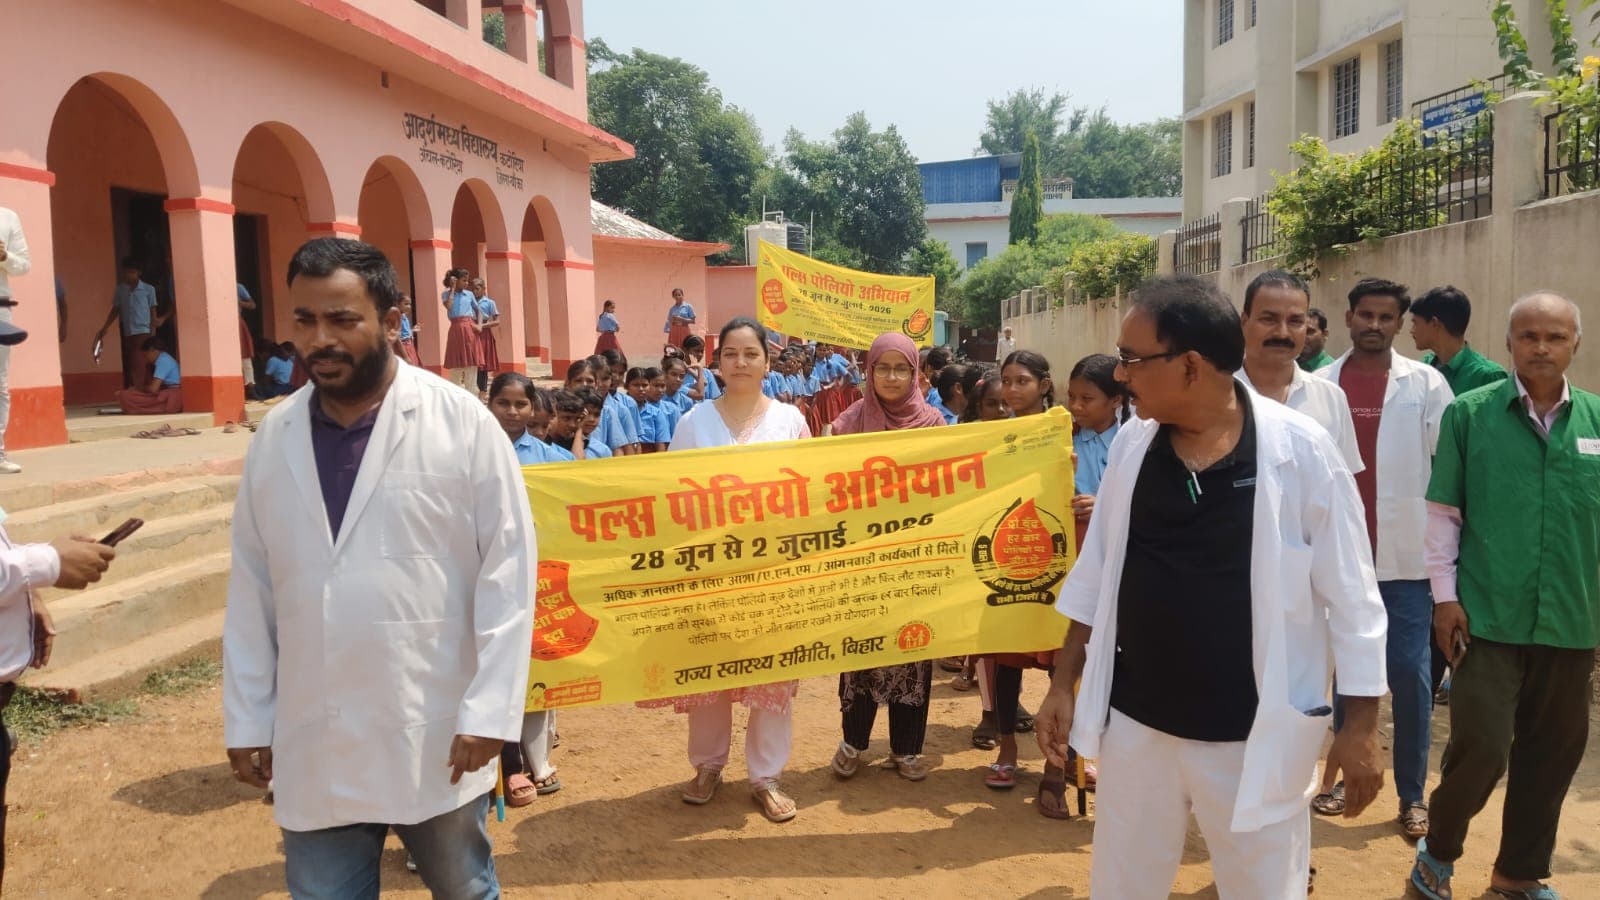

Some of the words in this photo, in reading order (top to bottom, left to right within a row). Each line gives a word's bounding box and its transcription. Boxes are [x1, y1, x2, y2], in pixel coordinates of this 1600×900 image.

[403, 112, 435, 146] आदर्श
[460, 124, 498, 162] विद्यालय
[811, 272, 854, 296] पोलियो
[859, 286, 911, 304] अभियान
[566, 496, 656, 542] पल्स
[665, 468, 811, 531] पोलियो
[824, 451, 988, 513] अभियान
[603, 588, 636, 603] अधिक
[641, 582, 685, 598] जानकारी
[702, 577, 724, 589] लिए
[924, 544, 933, 556] से
[631, 550, 664, 571] 28
[674, 543, 716, 572] जून
[722, 535, 744, 560] से
[752, 537, 767, 557] 2
[674, 665, 712, 686] राज्य
[717, 654, 775, 678] स्वास्थ्य
[779, 641, 836, 668] समिति,
[841, 635, 887, 657] बिहार
